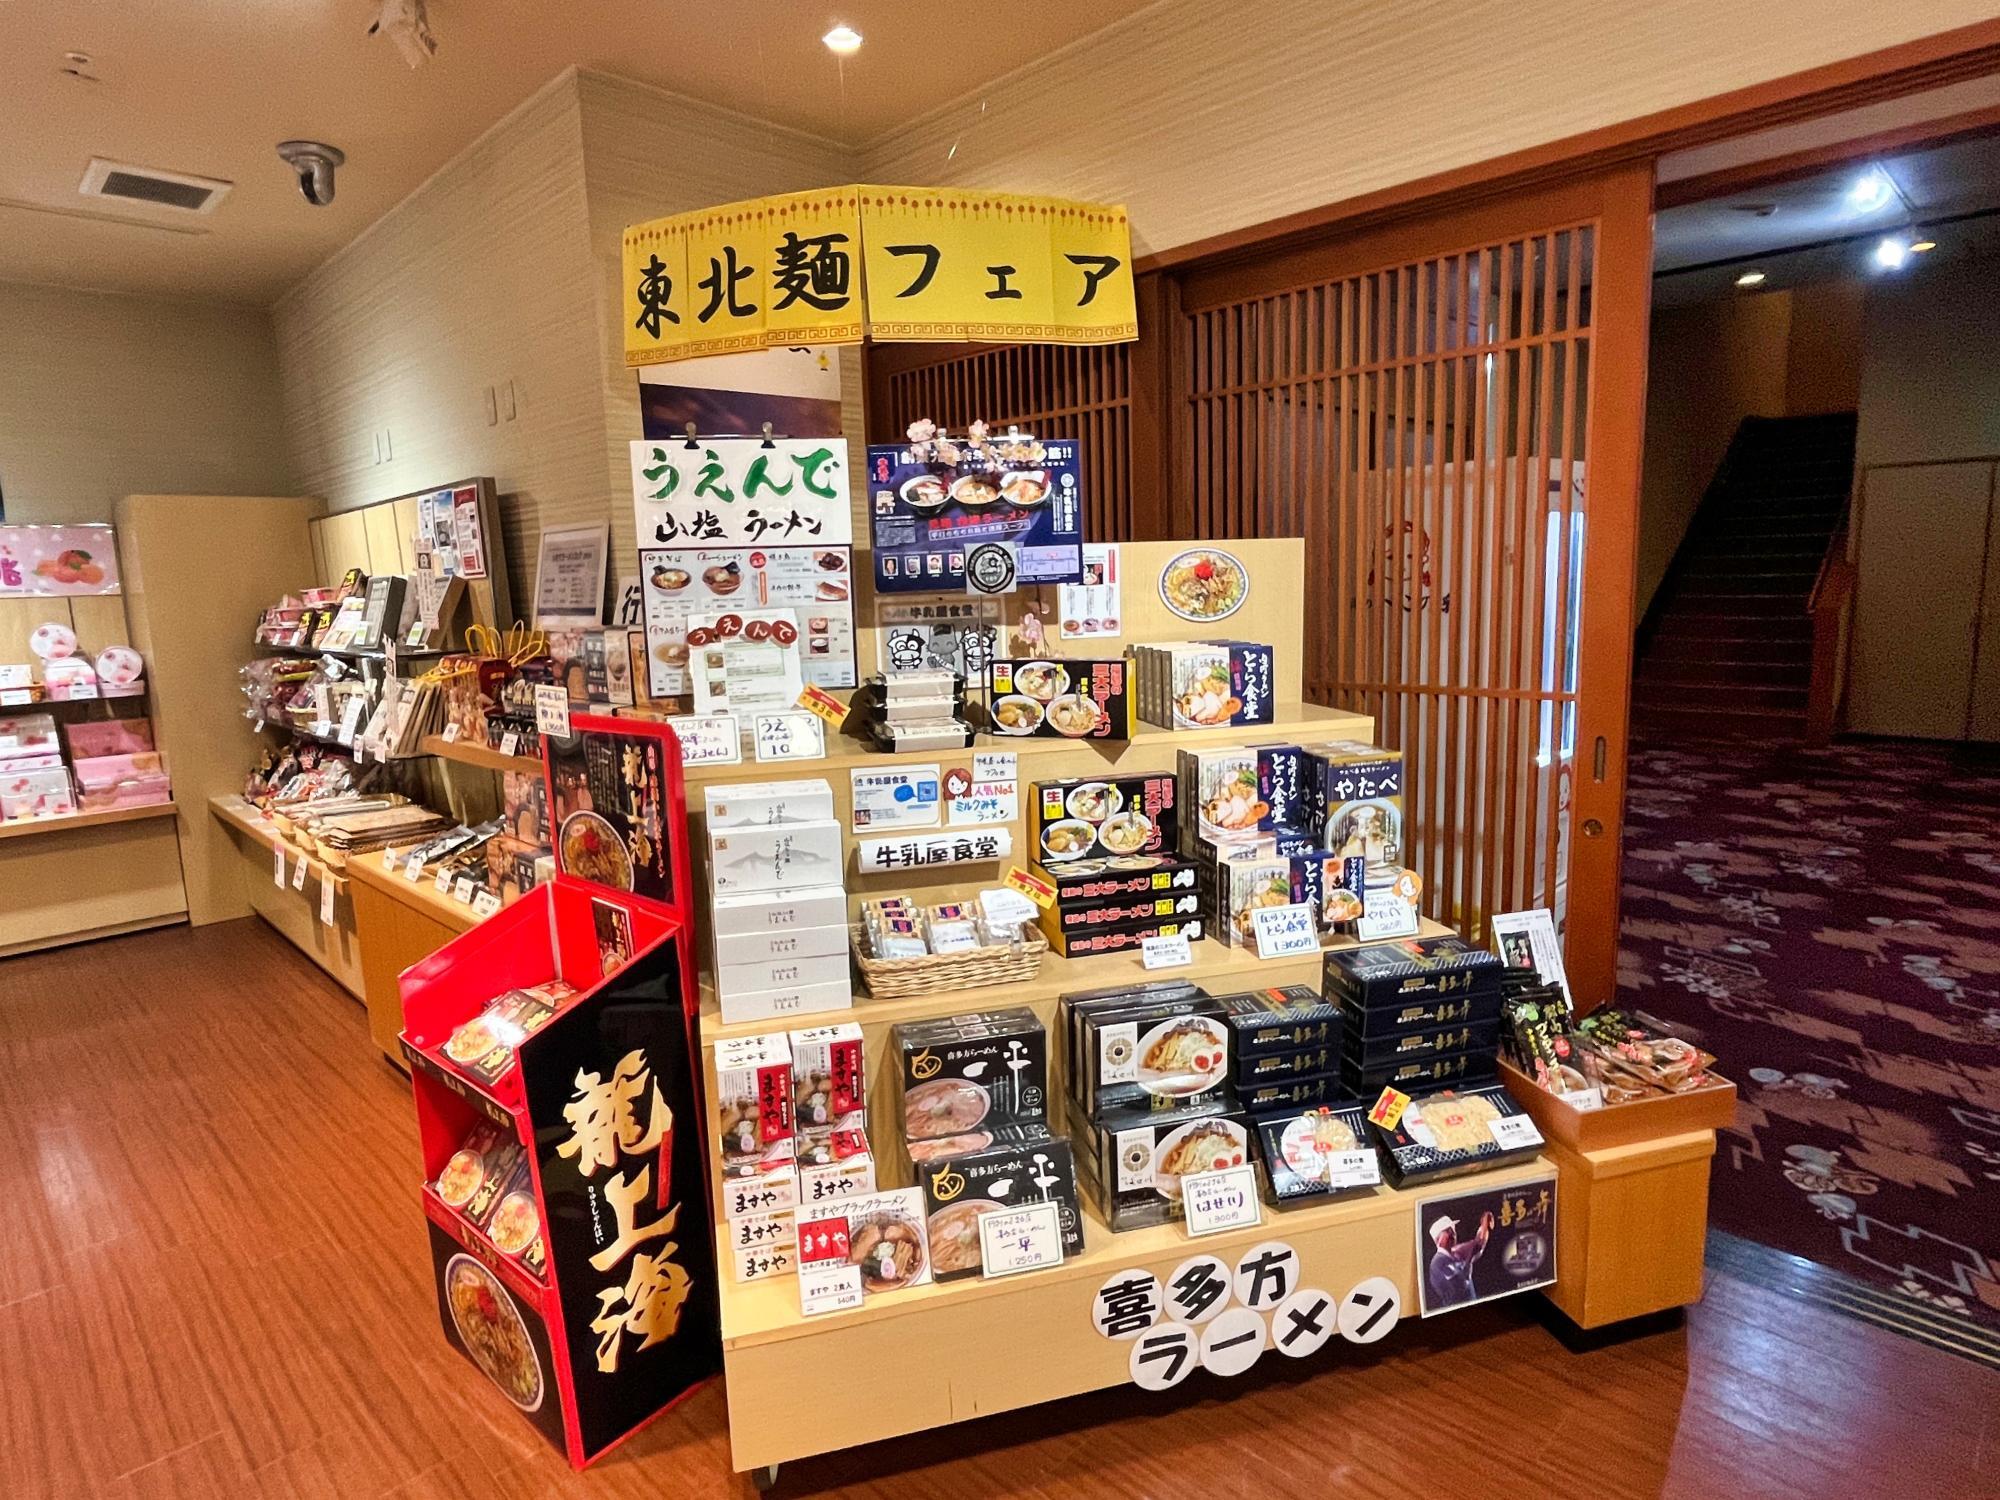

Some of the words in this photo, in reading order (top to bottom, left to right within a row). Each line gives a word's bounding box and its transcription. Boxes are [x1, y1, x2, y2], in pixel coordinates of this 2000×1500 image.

[635, 231, 1122, 340] 東北麺フェア
[642, 447, 840, 504] うえんで
[655, 509, 729, 543] 山塩
[743, 509, 823, 543] ラーメン
[909, 604, 974, 619] 牛乳屋食堂
[696, 616, 793, 645] うえんで
[996, 666, 1009, 677] 生
[1242, 650, 1260, 720] とら食堂
[867, 775, 909, 787] 牛乳屋食堂
[1269, 752, 1288, 824] とら食堂
[1334, 773, 1399, 800] やたべ
[621, 743, 653, 867] 龍上海
[955, 798, 998, 812] ミルクみそ
[1046, 791, 1061, 803] 生
[875, 836, 999, 868] 牛乳屋食堂
[1266, 920, 1308, 936] とら食堂
[947, 1046, 999, 1061] 喜多方らーめん
[968, 1161, 1024, 1178] 喜多方らーめん
[812, 1178, 854, 1200] ますや
[555, 1048, 694, 1374] 龍上海
[734, 1190, 778, 1214] ますや
[809, 1195, 907, 1220] ますやブラックラーメン
[1196, 1191, 1244, 1212] はせ川
[740, 1222, 783, 1245] ますや
[803, 1231, 847, 1254] ますや
[745, 1255, 787, 1278] ますや
[809, 1286, 830, 1297] ますや
[1099, 1249, 1293, 1338] 喜多方
[1137, 1292, 1394, 1382] ラーメン
